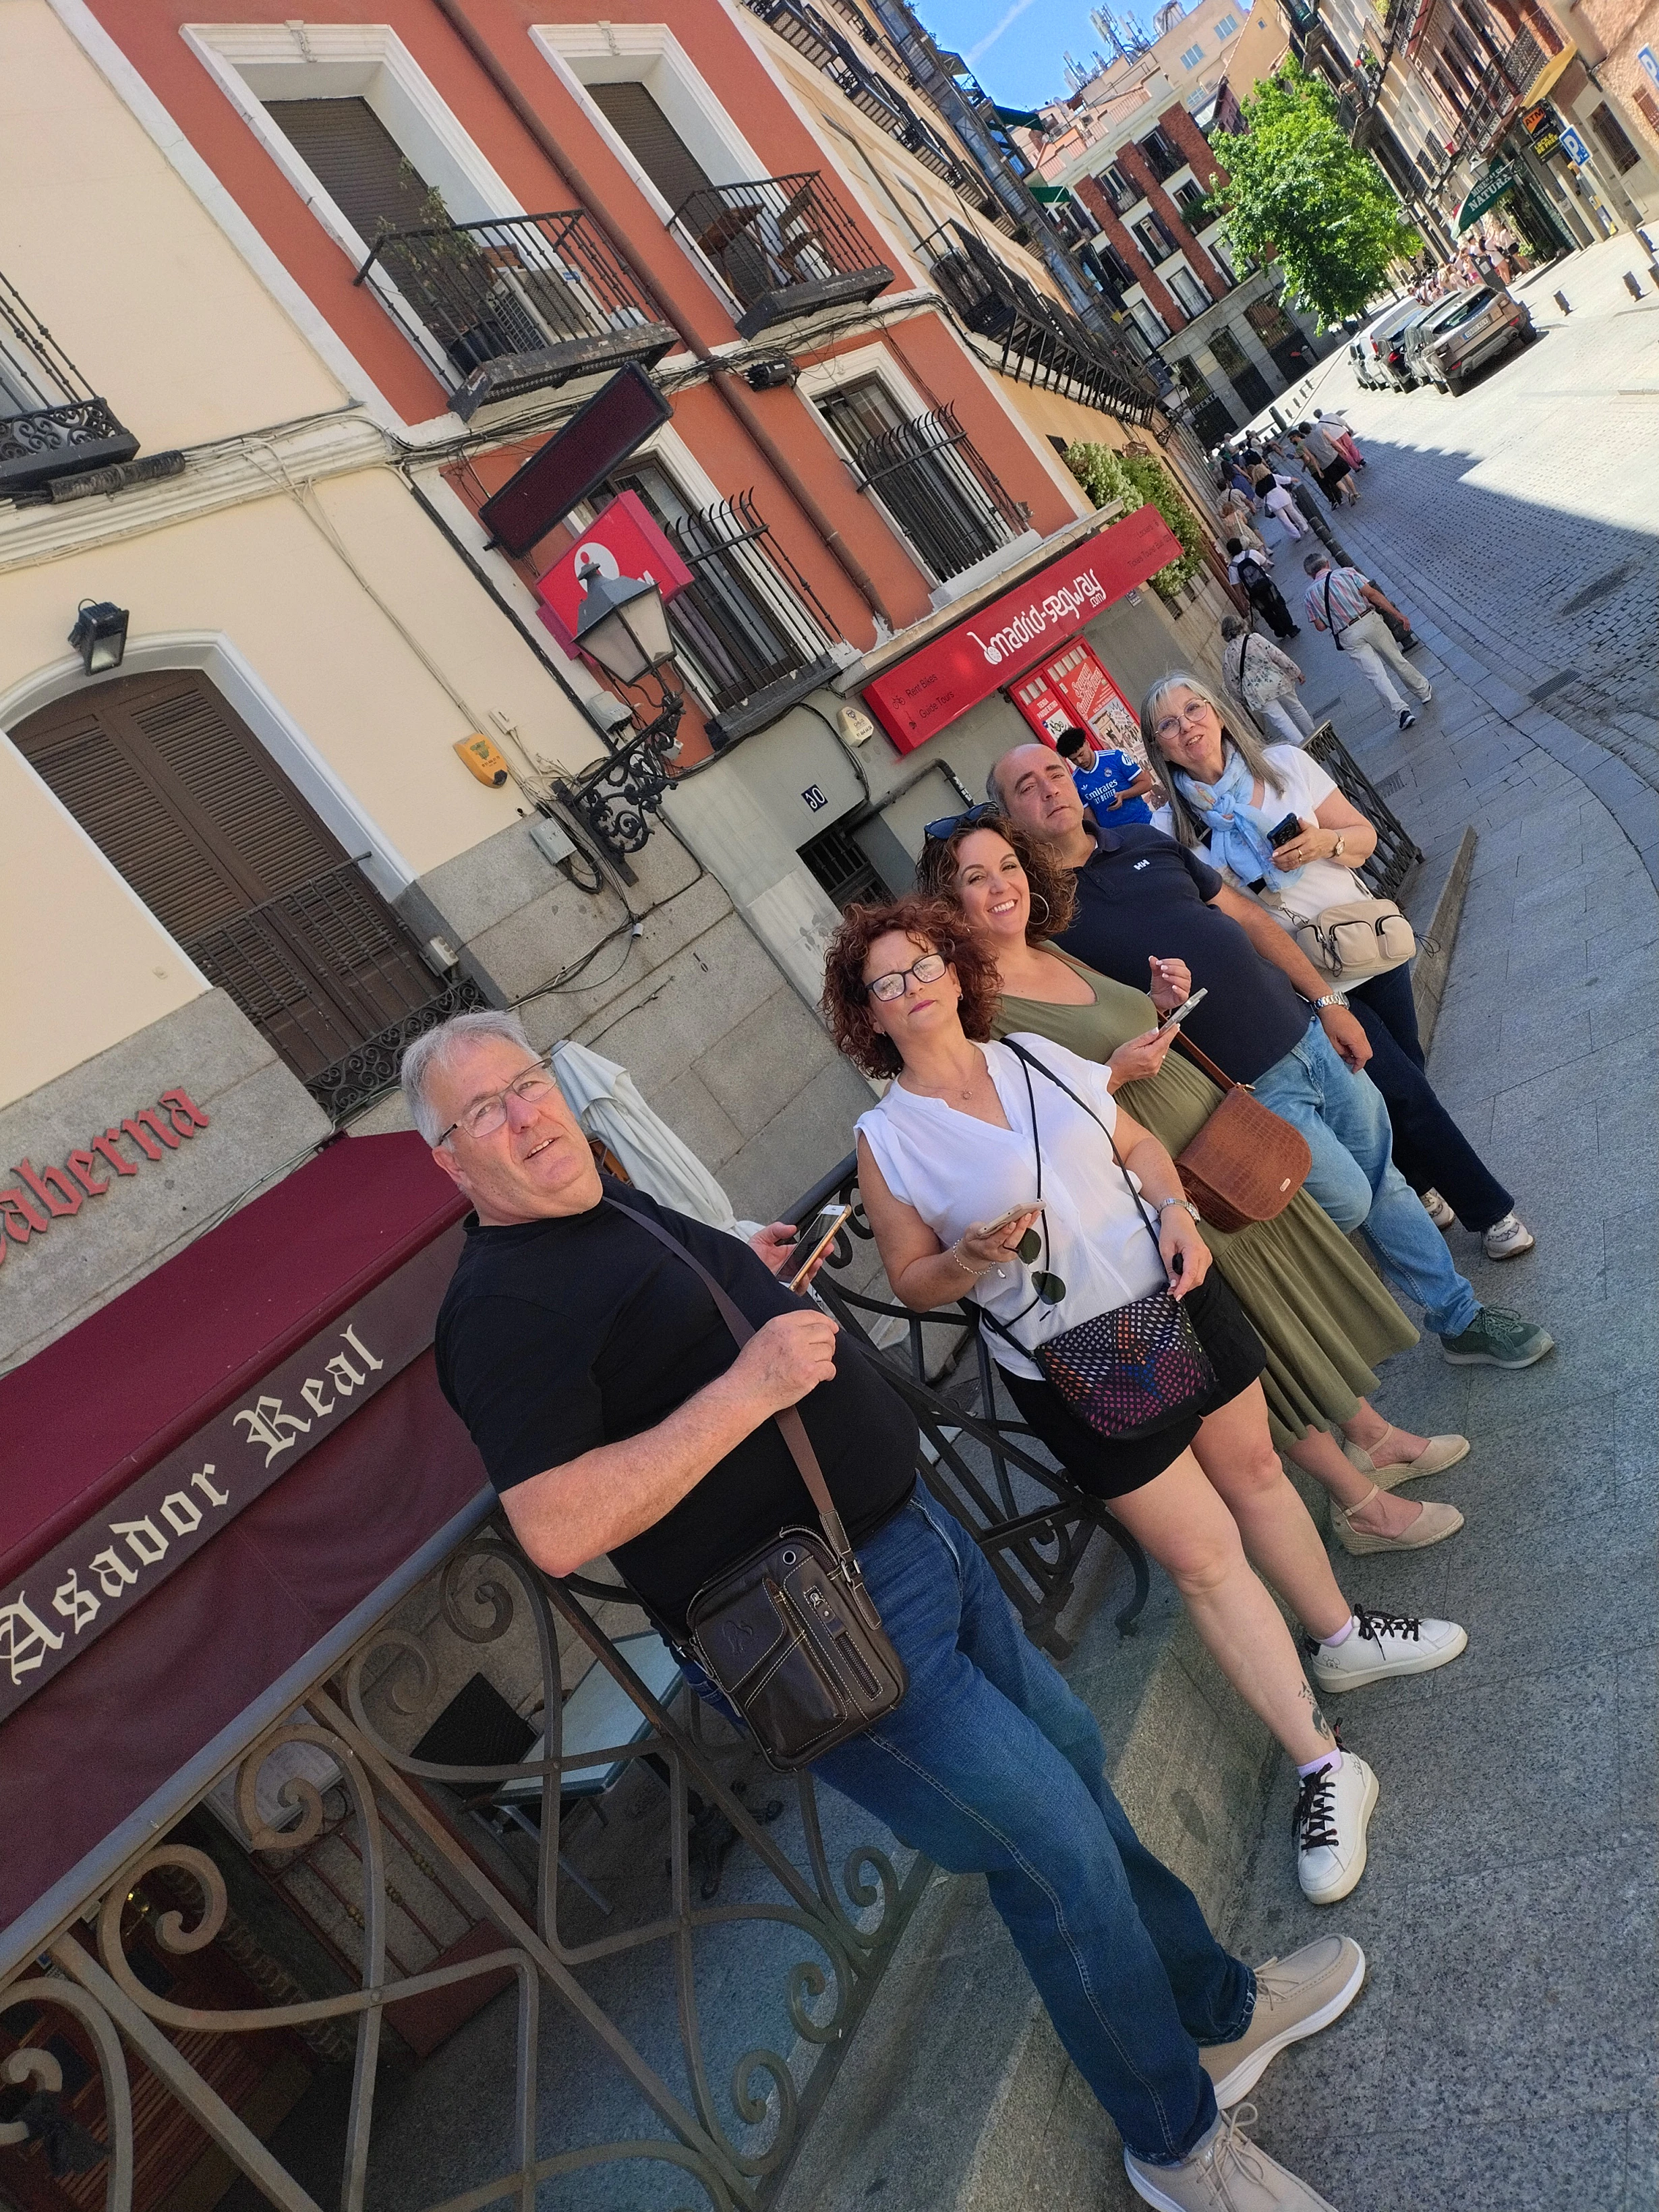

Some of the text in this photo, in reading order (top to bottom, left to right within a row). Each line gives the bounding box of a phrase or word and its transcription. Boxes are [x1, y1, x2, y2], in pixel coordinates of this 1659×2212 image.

[1525, 108, 1544, 127] ATM
[1536, 146, 1546, 154] BE
[1544, 134, 1559, 148] FREE
[1564, 135, 1581, 163] P
[905, 674, 937, 699] Rent Bikes
[919, 691, 954, 718] Guide Tours
[1084, 779, 1118, 800] Emirates
[0, 1086, 209, 1264] aberna
[0, 1324, 384, 1685] Asador Real
